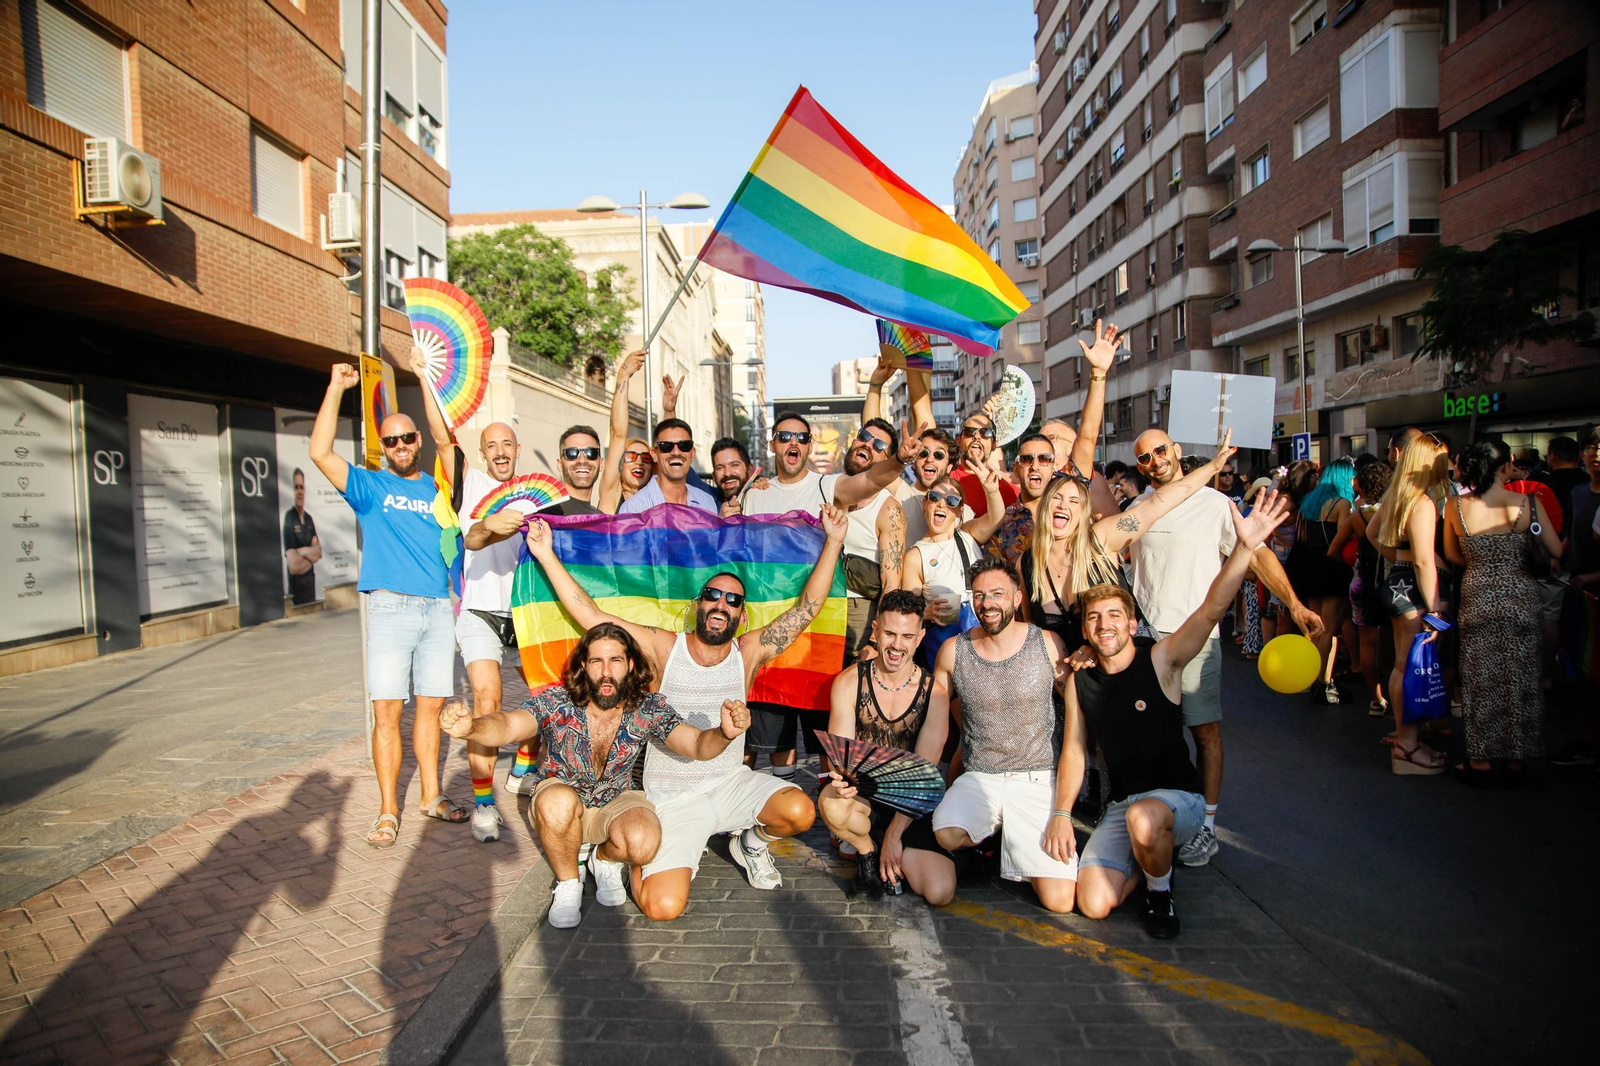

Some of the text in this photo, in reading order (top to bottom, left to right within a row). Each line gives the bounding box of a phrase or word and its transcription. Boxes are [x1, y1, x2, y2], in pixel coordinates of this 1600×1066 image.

[157, 420, 180, 440] San
[94, 450, 124, 485] SP
[241, 456, 269, 497] SP
